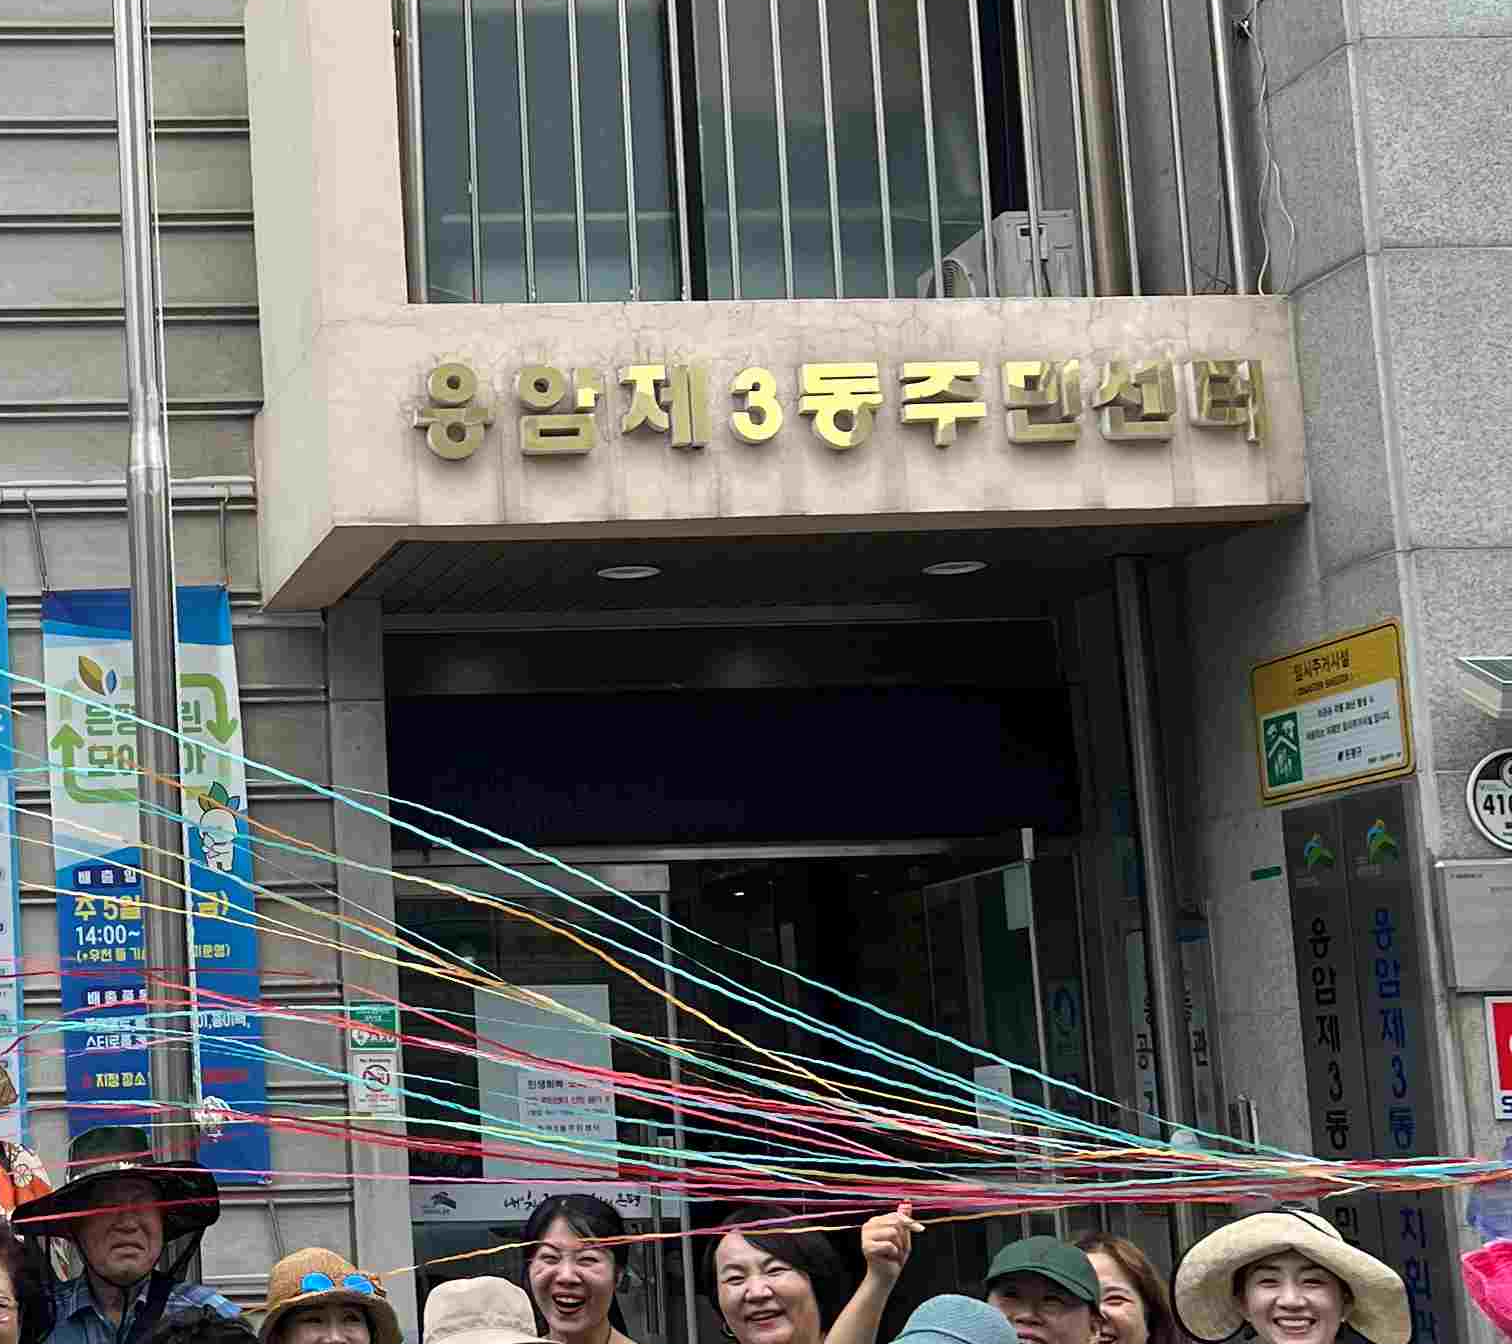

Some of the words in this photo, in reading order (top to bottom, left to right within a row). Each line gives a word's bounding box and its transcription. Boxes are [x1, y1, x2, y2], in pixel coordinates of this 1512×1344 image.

[414, 358, 1267, 460] 응암제3동주민센터
[1483, 794, 1512, 816] 41
[73, 896, 97, 921] 주
[75, 925, 143, 947] 14:00~
